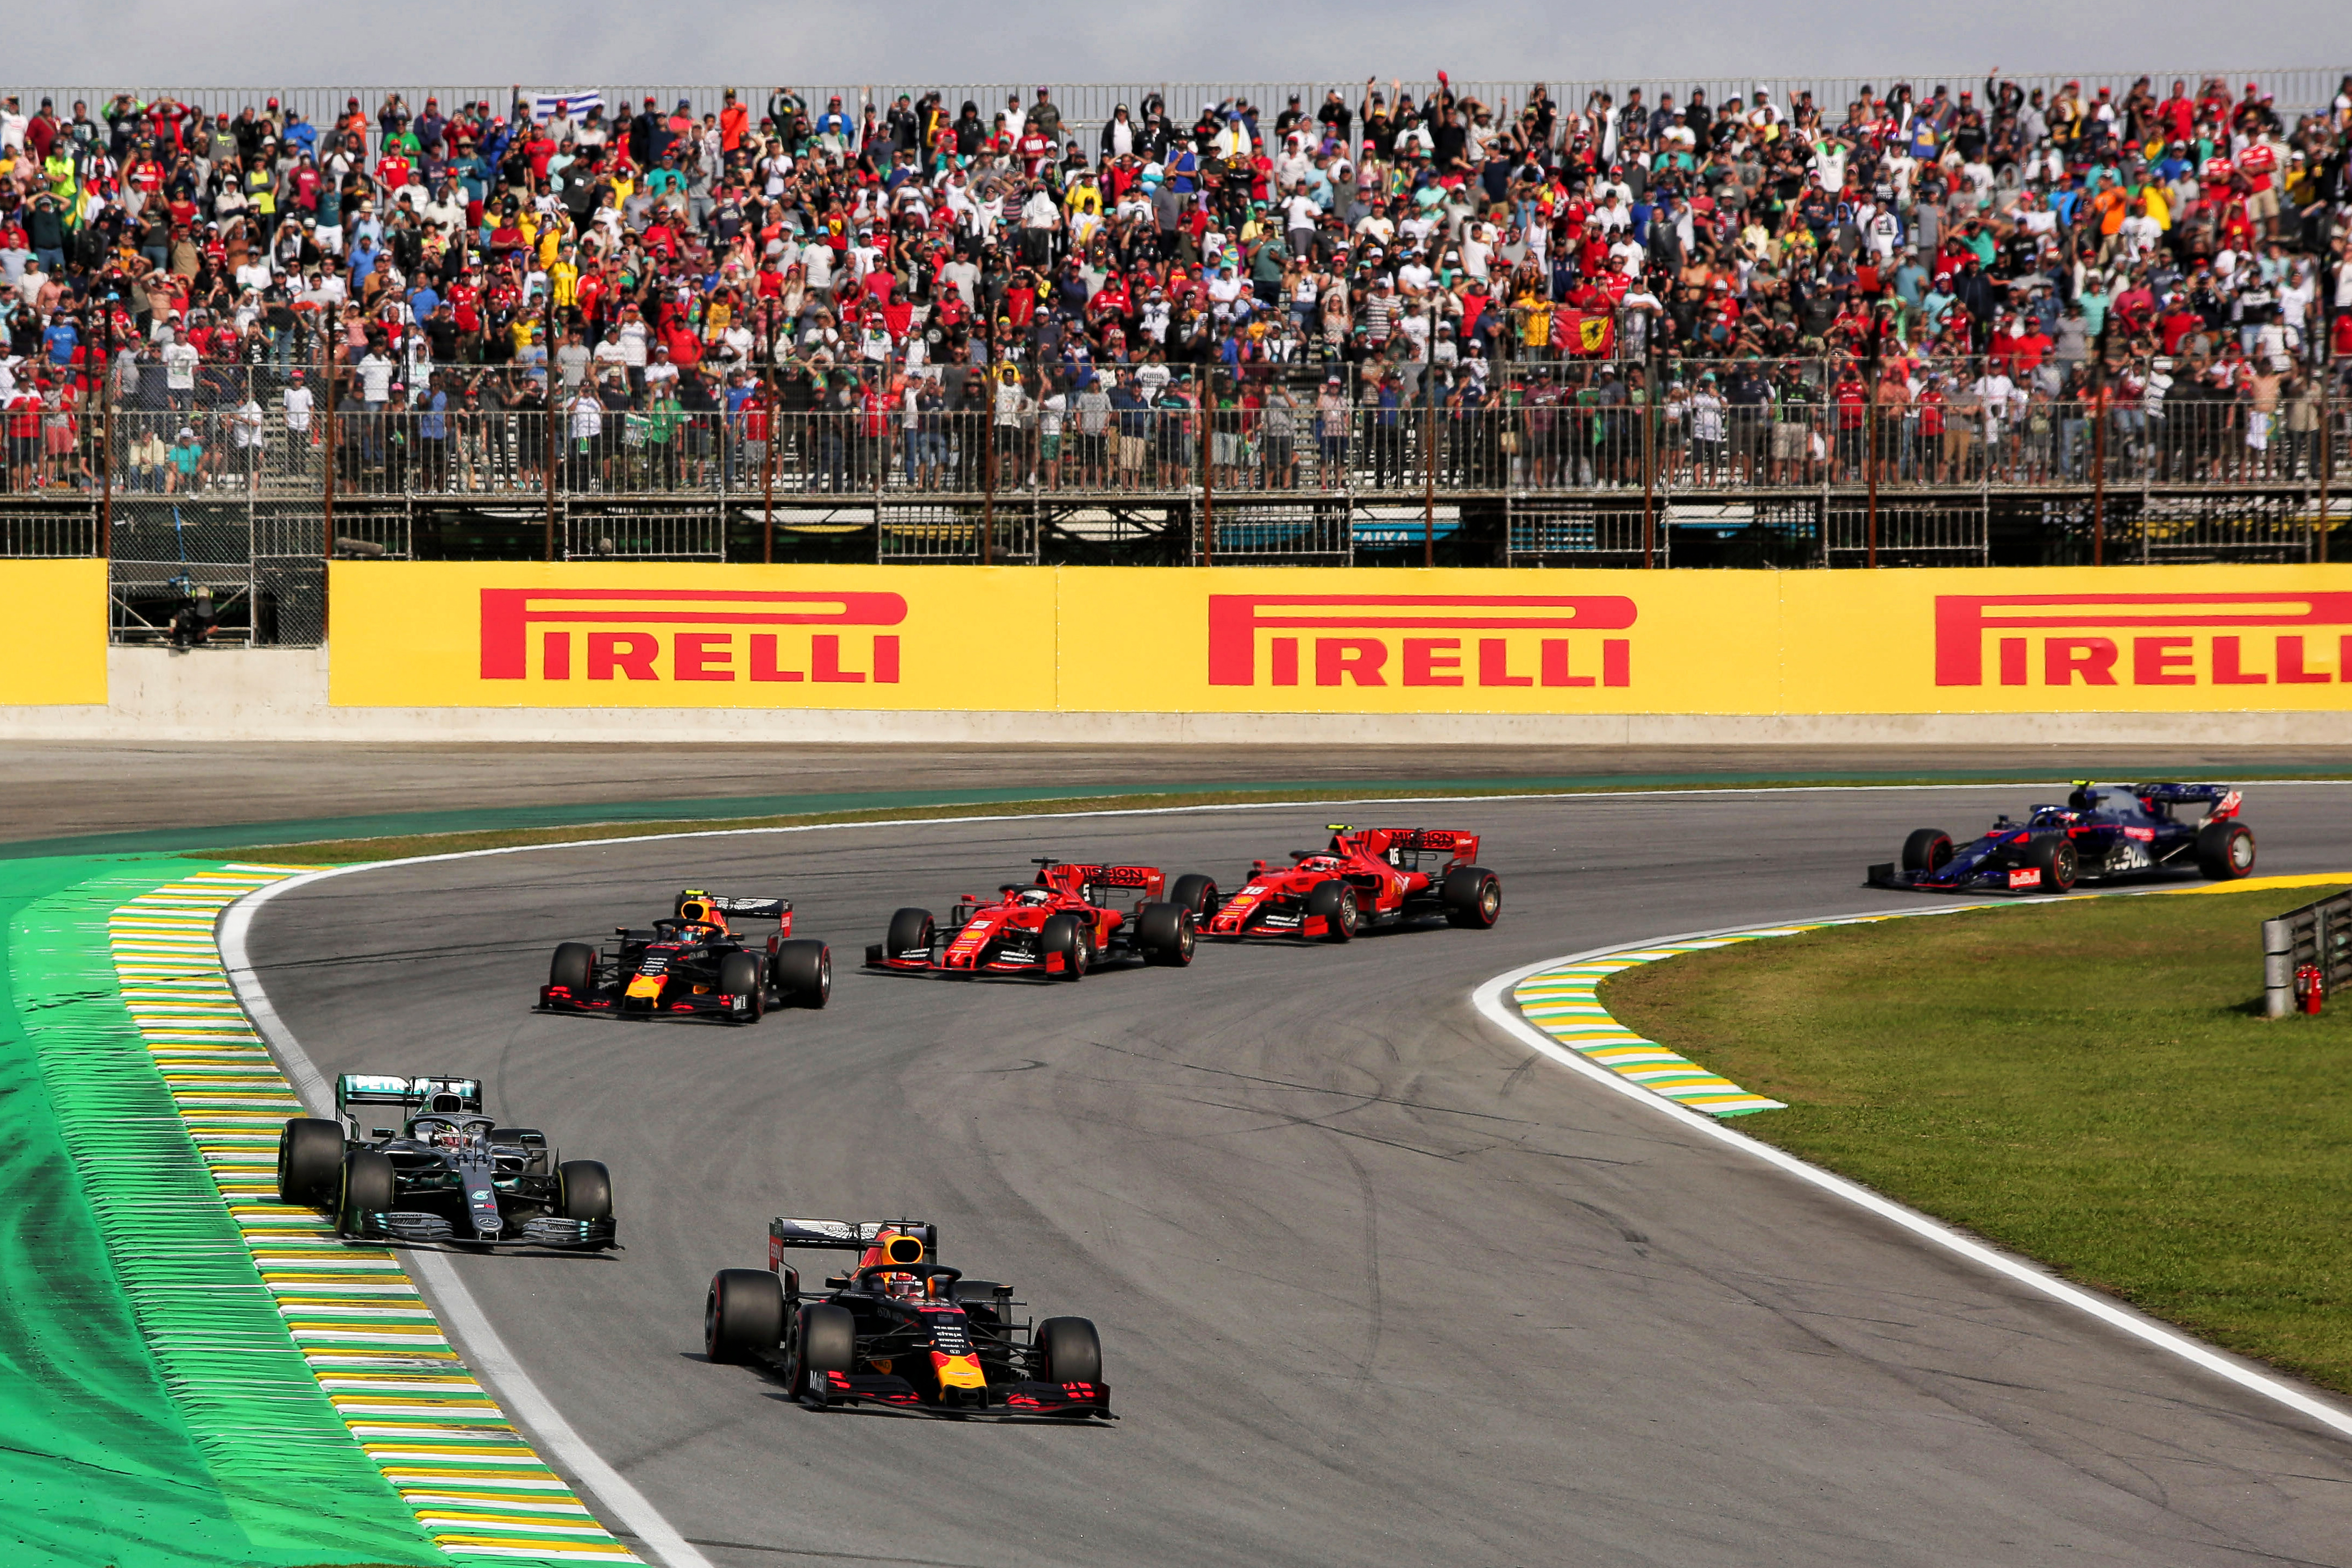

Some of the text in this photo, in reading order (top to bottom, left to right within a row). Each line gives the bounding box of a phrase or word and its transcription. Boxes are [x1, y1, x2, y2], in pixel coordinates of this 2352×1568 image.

[480, 588, 908, 683] PIRELLI
[1208, 594, 1637, 687] PIRELLI
[1389, 848, 1399, 865] 16
[1083, 884, 1090, 901] 5
[1241, 886, 1269, 894] 16
[968, 921, 993, 929] 5
[357, 1074, 462, 1093] PETRONS
